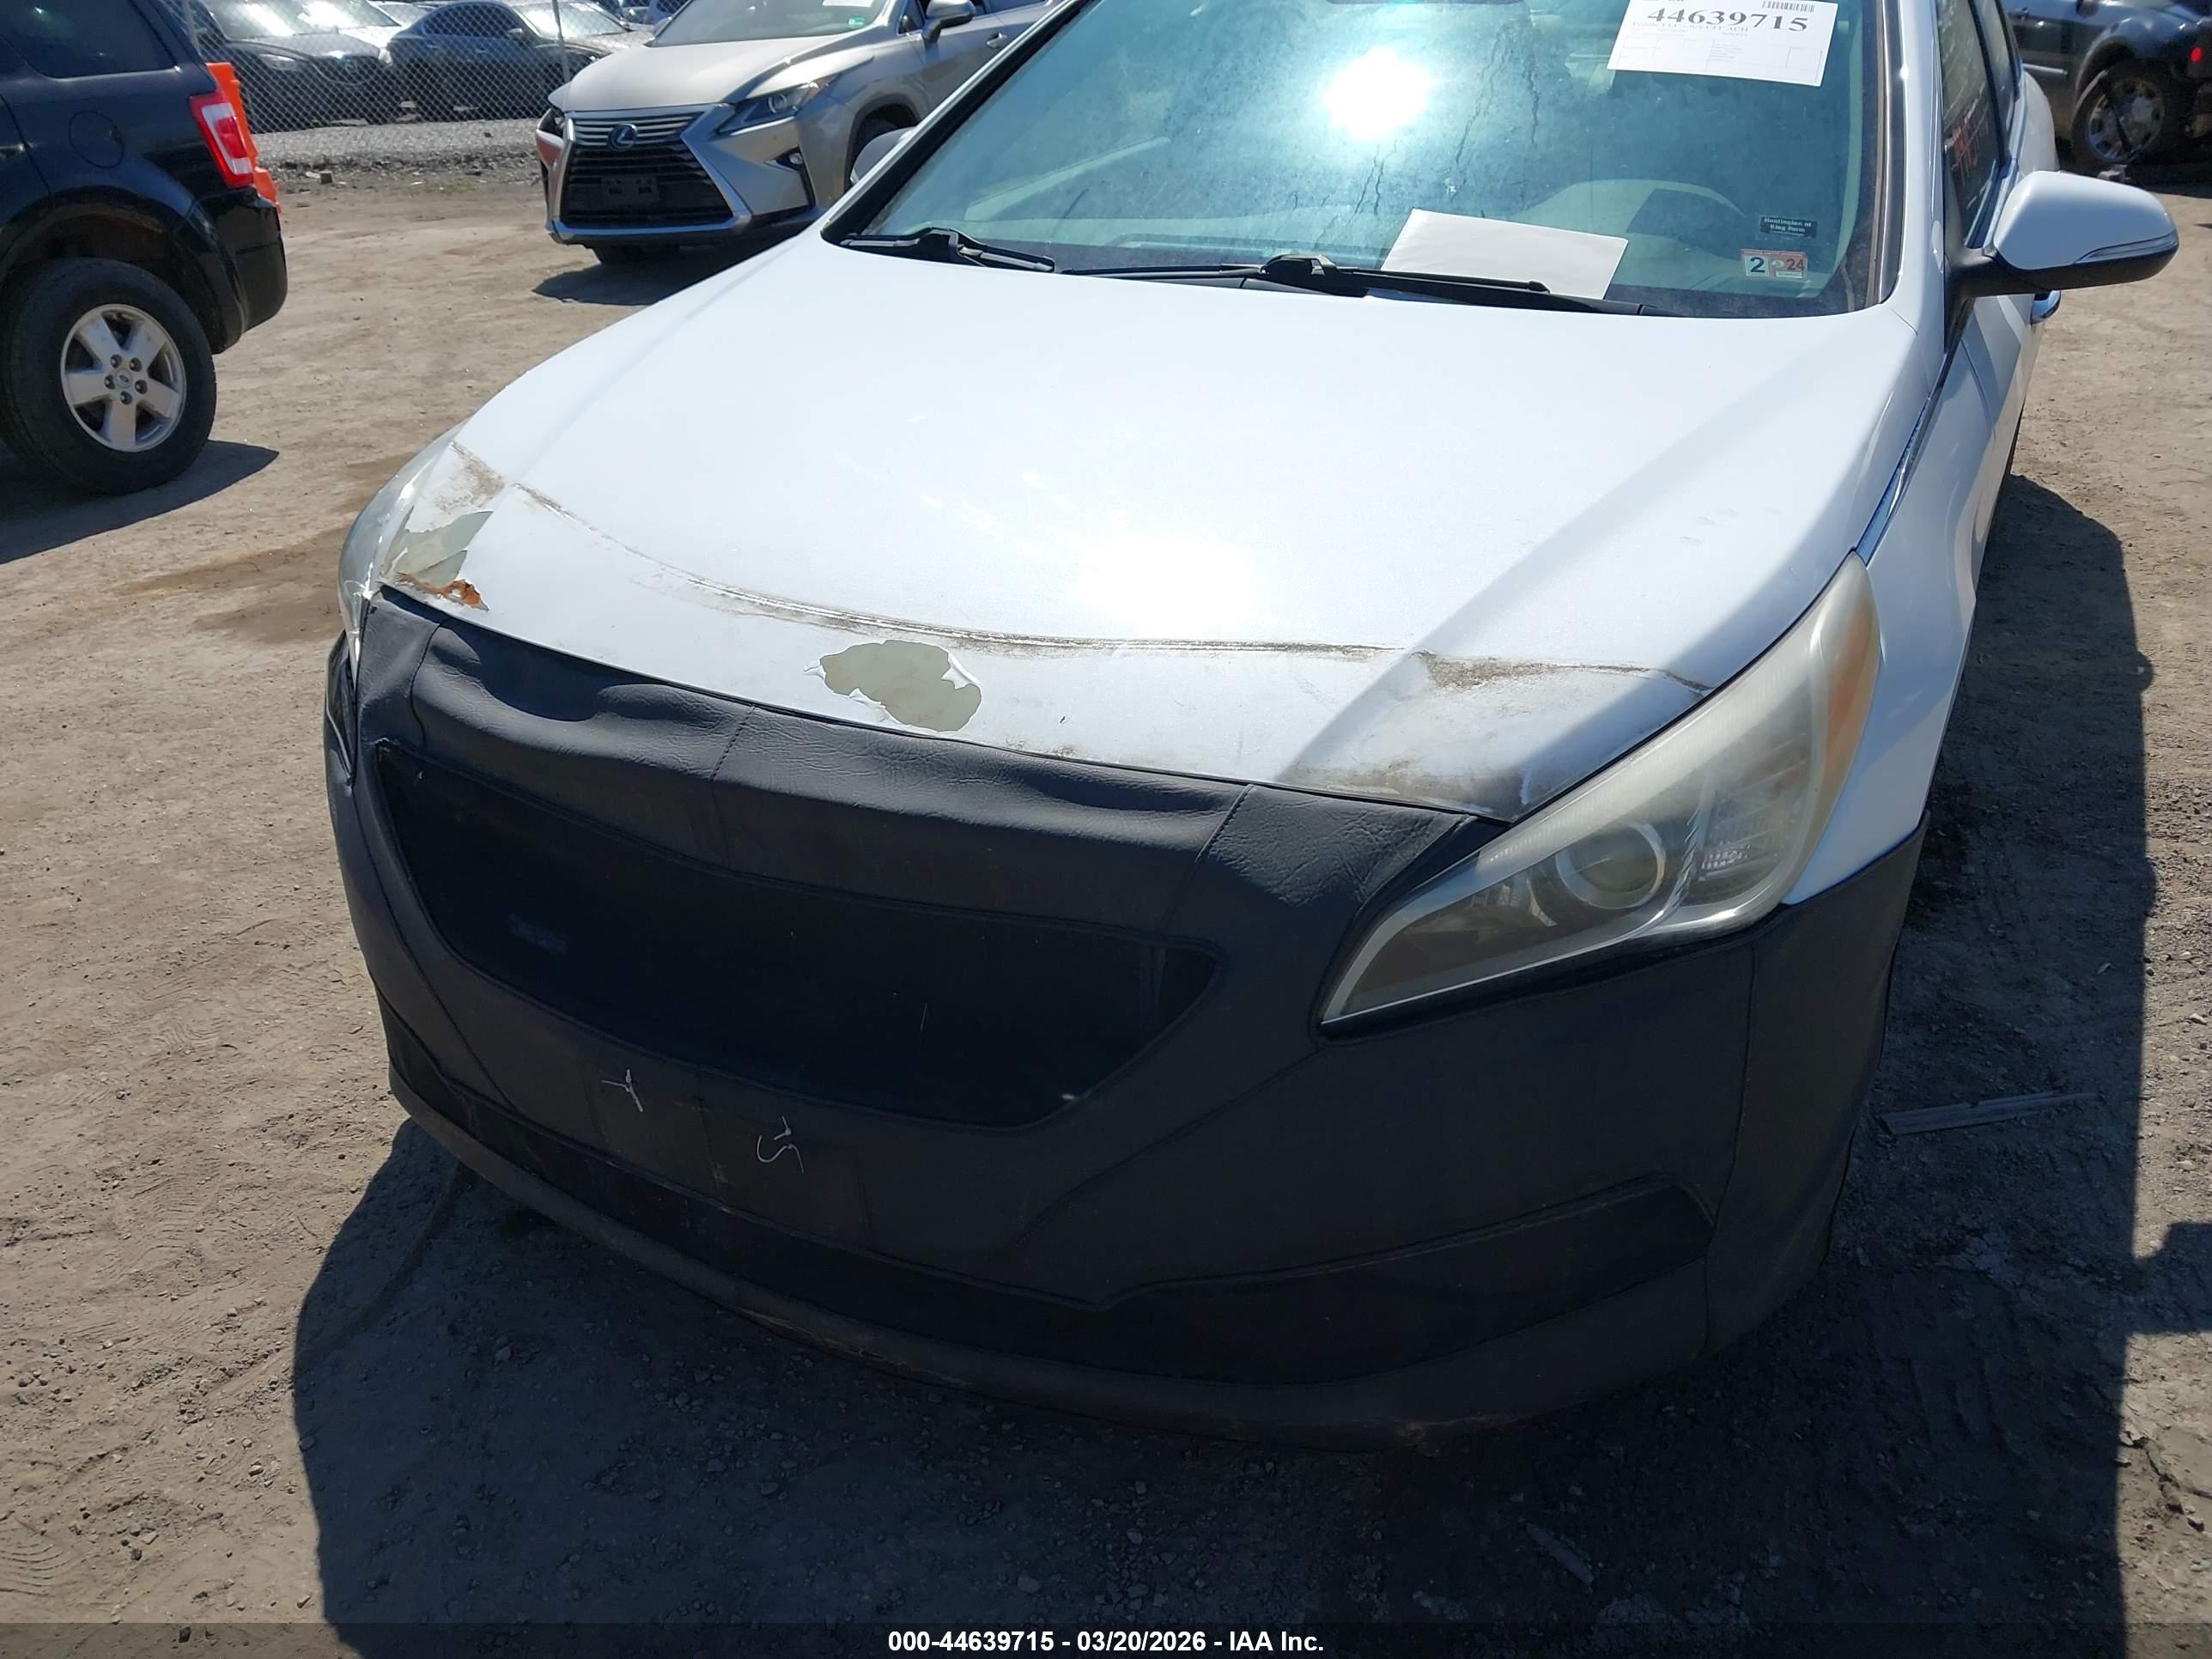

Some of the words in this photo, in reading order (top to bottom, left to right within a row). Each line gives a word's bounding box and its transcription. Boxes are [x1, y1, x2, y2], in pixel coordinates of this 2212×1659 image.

[1647, 7, 1808, 33] 44639715
[1750, 257, 1765, 273] 2
[1786, 258, 1806, 271] 24
